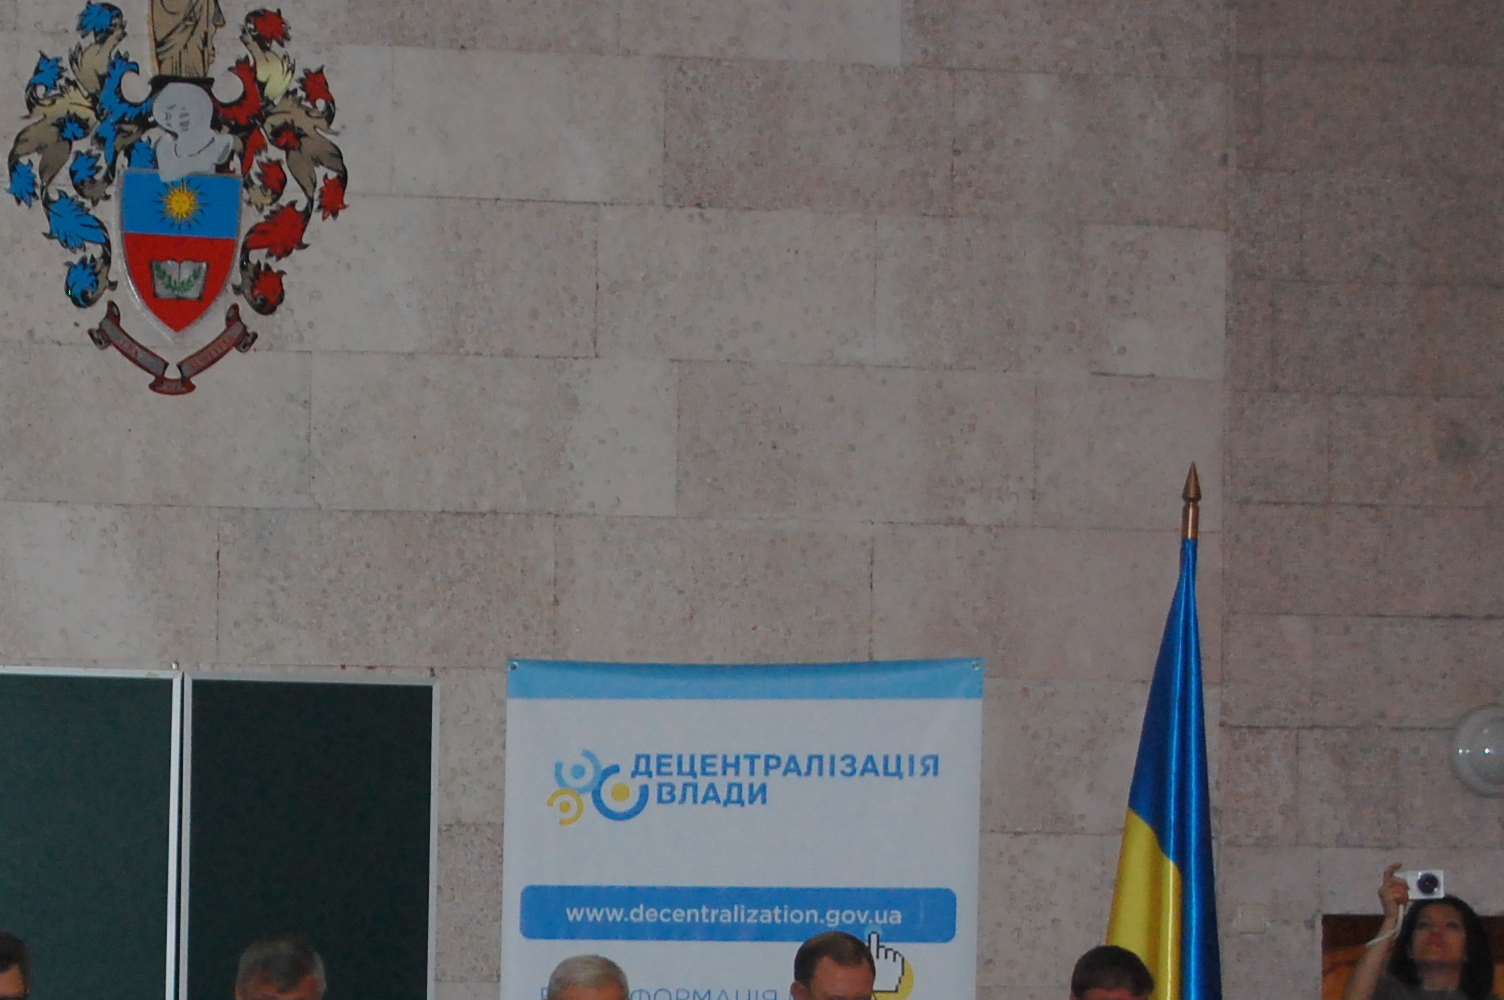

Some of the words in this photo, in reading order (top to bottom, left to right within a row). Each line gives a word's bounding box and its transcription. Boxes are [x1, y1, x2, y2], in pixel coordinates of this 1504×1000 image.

[630, 753, 940, 780] ДЕЦЕНТРАЛІЗАЦІЯ
[655, 781, 768, 808] ВЛАДИ
[564, 903, 903, 930] www.decentralization.gov.ua
